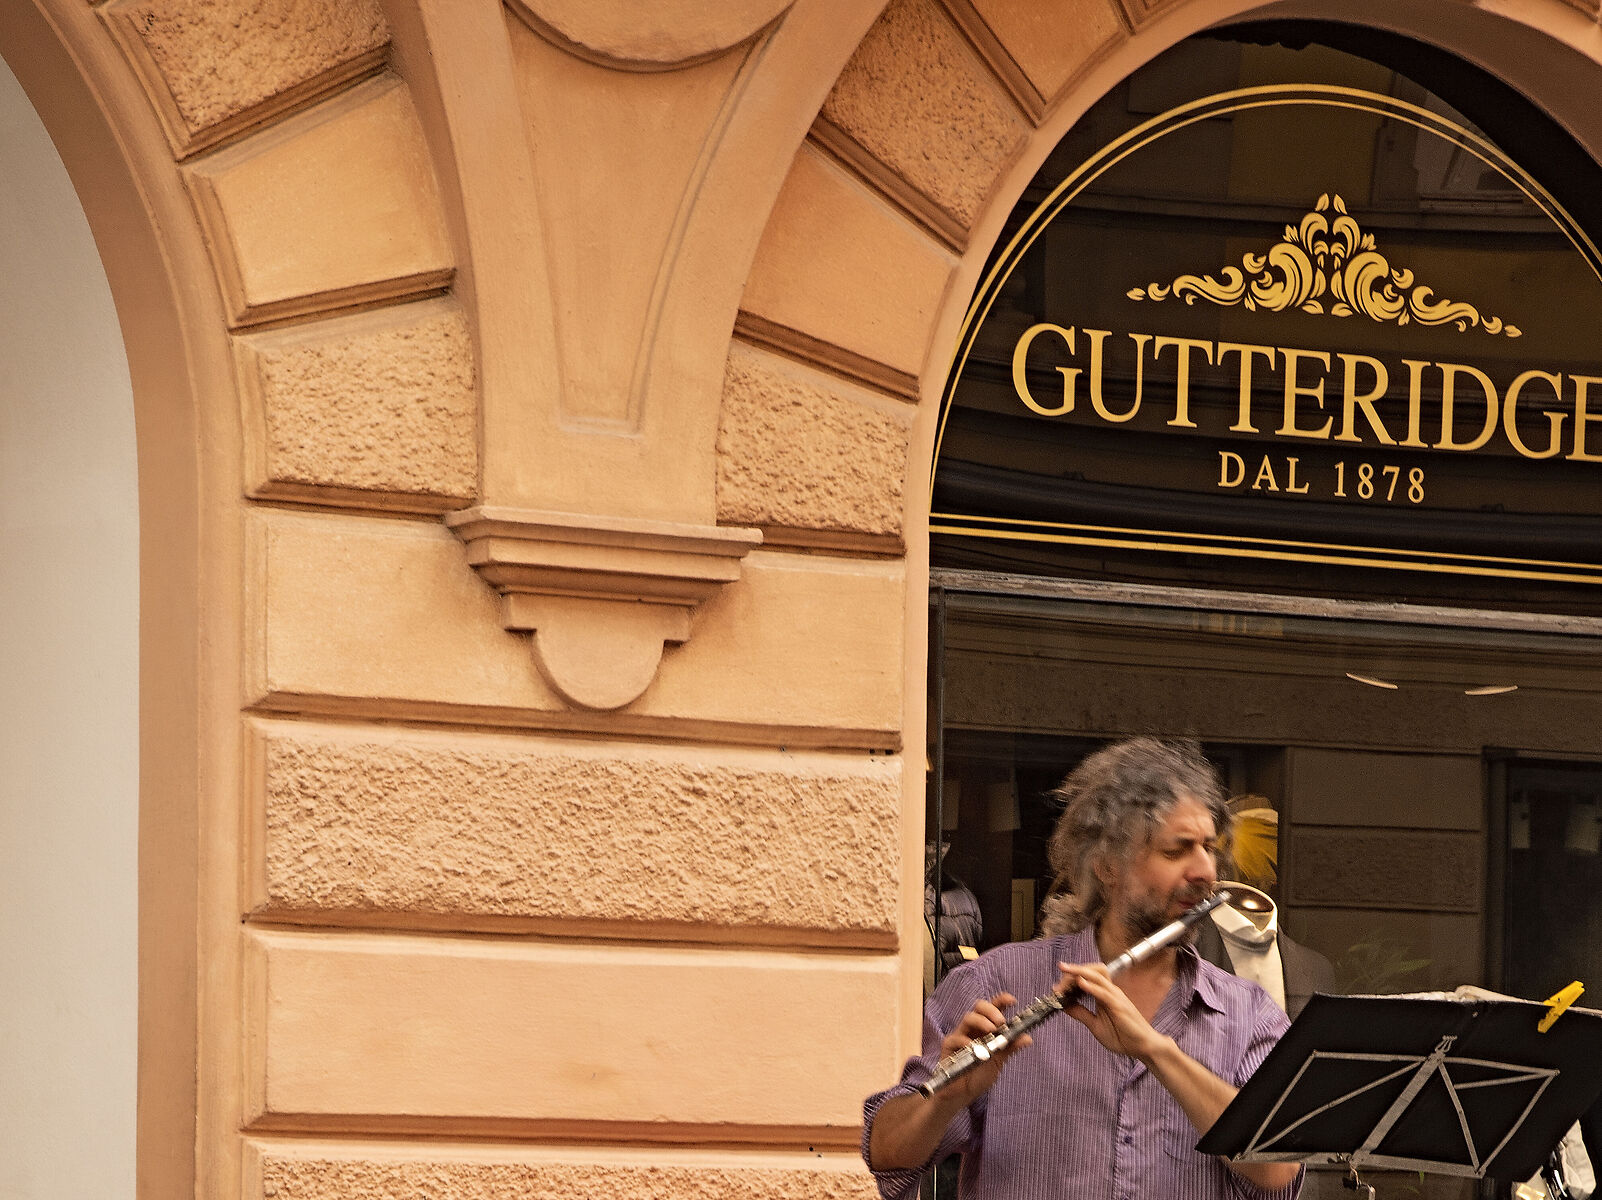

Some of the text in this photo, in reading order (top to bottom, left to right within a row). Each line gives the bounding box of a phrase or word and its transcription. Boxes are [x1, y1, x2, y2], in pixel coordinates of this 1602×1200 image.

[1012, 322, 1602, 463] GUTTERIDGE
[1217, 451, 1425, 504] DAL 1878
